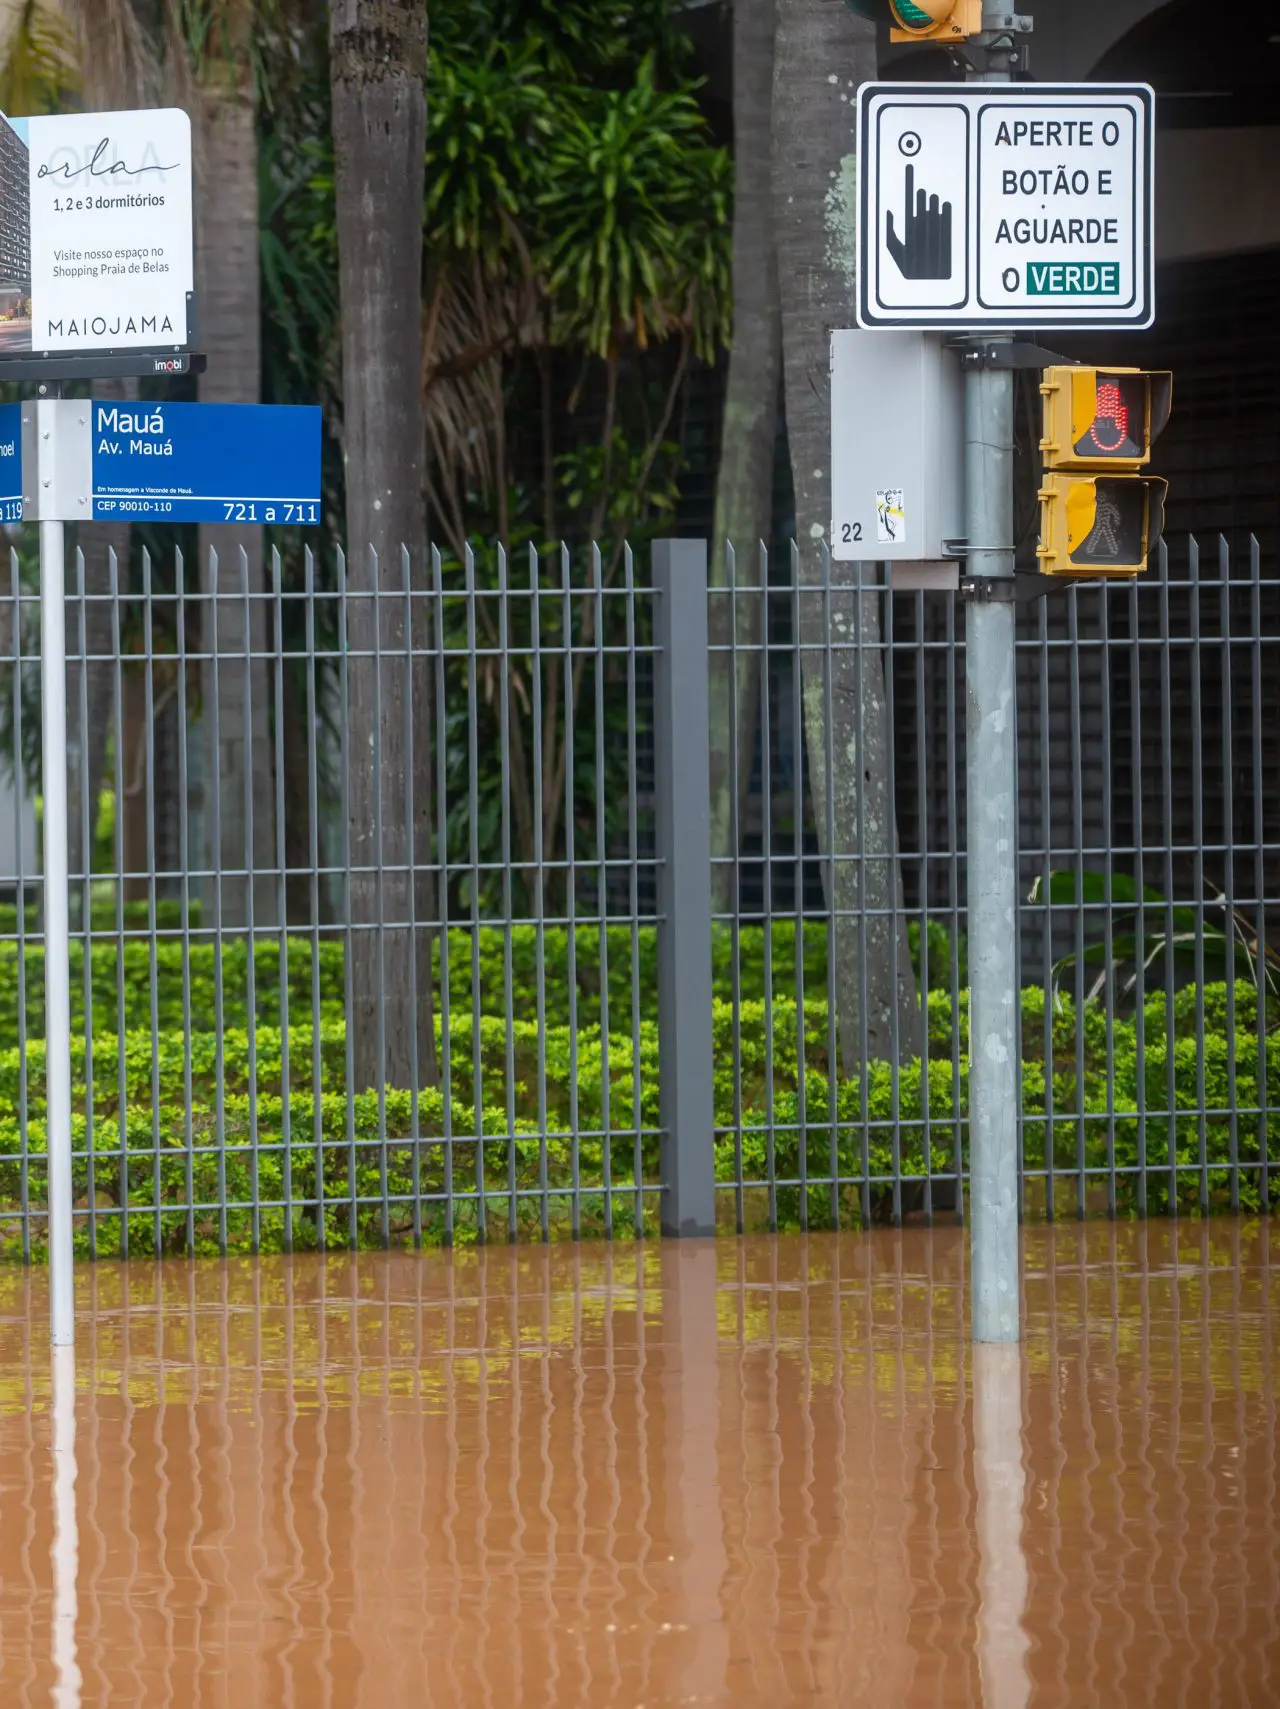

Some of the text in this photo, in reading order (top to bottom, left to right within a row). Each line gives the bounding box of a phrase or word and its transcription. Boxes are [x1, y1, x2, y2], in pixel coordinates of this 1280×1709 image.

[994, 121, 1120, 147] APERTE O
[37, 137, 181, 178] orla
[1002, 164, 1112, 195] BOTÃO E
[53, 194, 165, 212] 1, 2 e 3 dormitórios
[995, 218, 1118, 244] AGUARDE
[53, 248, 164, 261] Visite nosso espaço no
[53, 261, 169, 278] Shopping Praia de Belas
[1002, 266, 1116, 293] O VERDE
[48, 315, 173, 337] MAIOJAMA
[97, 407, 164, 434] Mauá
[98, 438, 173, 456] Av. Mauá
[108, 486, 140, 494] homenagem
[5, 502, 23, 520] 119
[97, 501, 172, 512] CEP 90010-110
[223, 503, 317, 522] 721 a 711
[841, 522, 863, 543] 22
